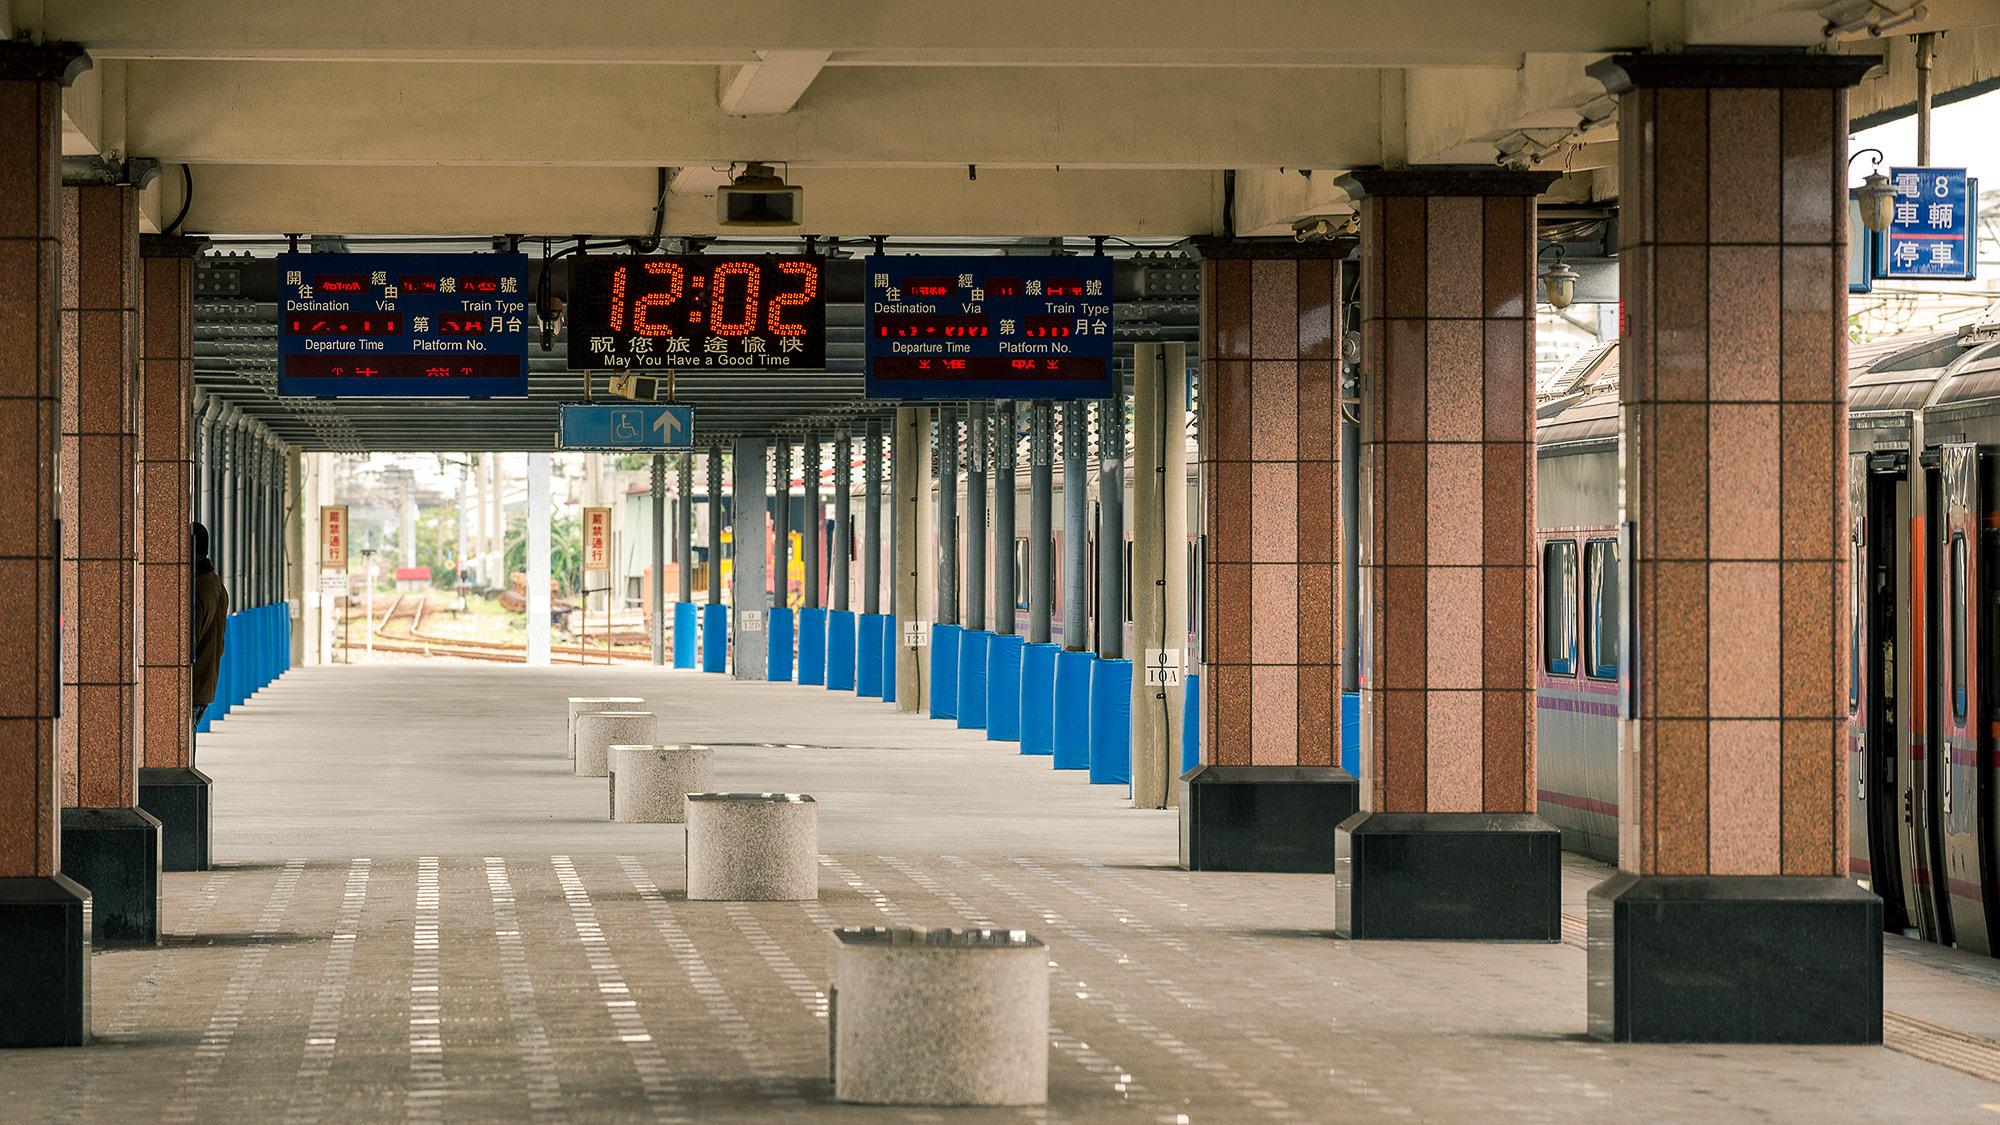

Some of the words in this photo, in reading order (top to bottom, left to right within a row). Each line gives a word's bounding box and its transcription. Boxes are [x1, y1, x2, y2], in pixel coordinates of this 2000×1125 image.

[1893, 241, 1955, 268] 停車
[439, 277, 456, 294] 線
[500, 277, 517, 294] 號
[1025, 279, 1042, 297] 線
[1086, 279, 1103, 297] 號
[286, 300, 350, 312] Destination
[375, 300, 395, 312] Via
[610, 262, 817, 336] 12:02
[461, 300, 492, 312] Train
[495, 300, 524, 315] Type
[874, 303, 936, 314] Destination
[962, 303, 982, 314] Via
[1045, 302, 1075, 315] Train
[1081, 303, 1110, 317] Type
[413, 317, 430, 333] 第
[489, 316, 523, 333] 月台
[1000, 319, 1016, 335] 第
[1075, 319, 1108, 336] 月台
[305, 339, 356, 352] Departure
[359, 339, 384, 350] Time
[413, 340, 463, 351] Platform
[466, 340, 487, 351] No.
[590, 336, 804, 353] 祝您旅途愉快
[892, 342, 943, 355] Departure
[946, 342, 970, 352] Time
[999, 342, 1048, 353] Platform
[1051, 342, 1072, 353] No.
[604, 355, 631, 368] May
[636, 355, 661, 366] You
[667, 355, 700, 366] Have
[705, 357, 713, 366] a
[718, 355, 753, 366] Good
[758, 355, 790, 366] Time
[1150, 670, 1176, 682] 10A
